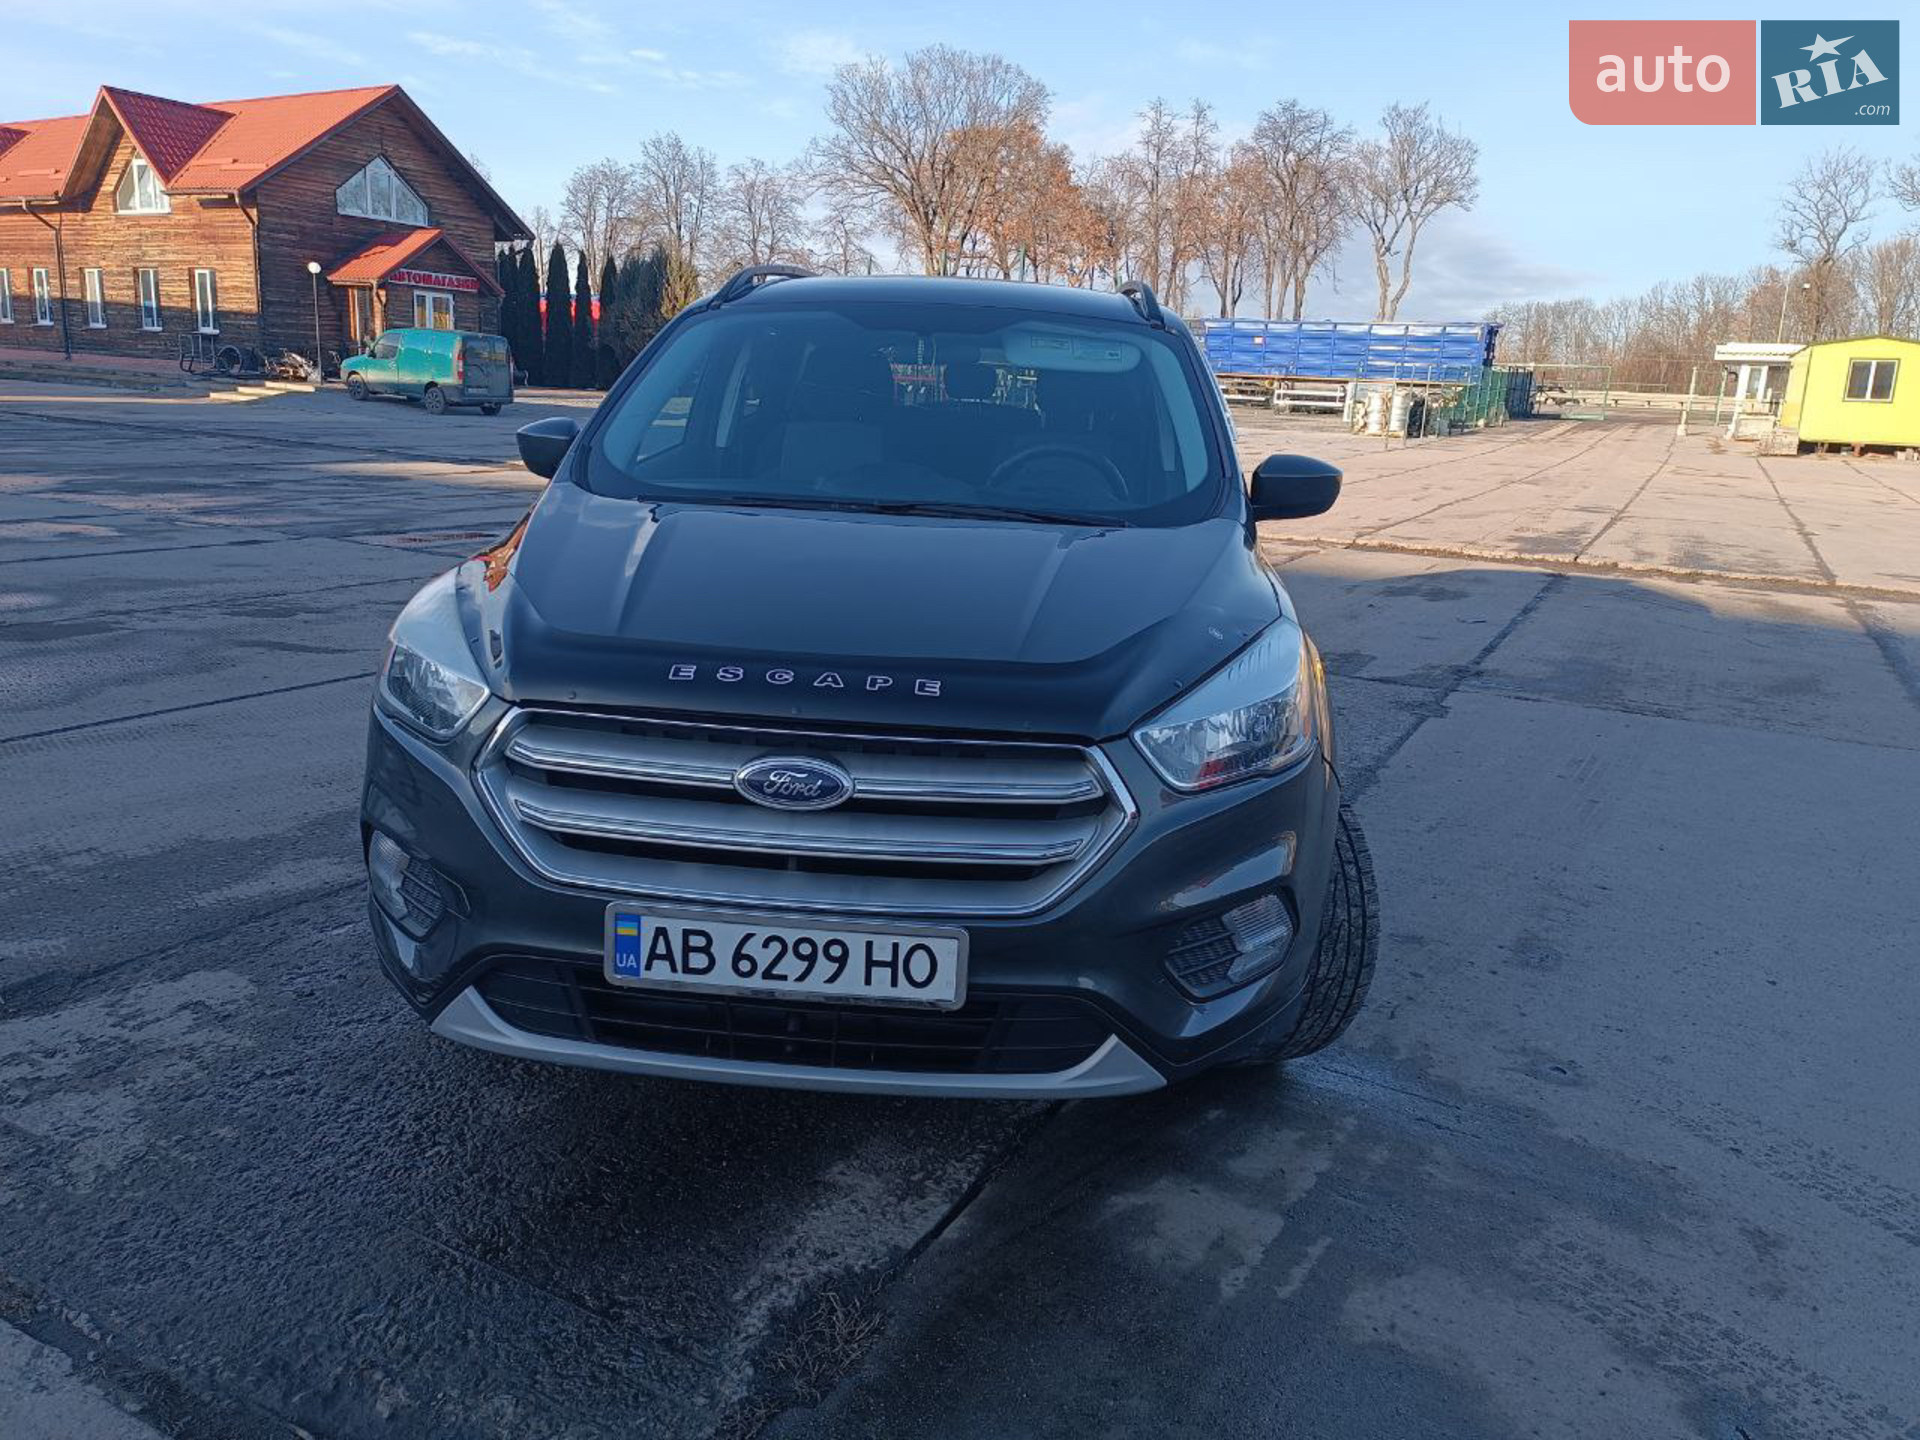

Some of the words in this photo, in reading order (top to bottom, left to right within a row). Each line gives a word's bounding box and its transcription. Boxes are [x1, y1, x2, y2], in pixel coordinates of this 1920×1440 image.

[668, 664, 942, 697] ESCAPE
[763, 770, 822, 798] Ford
[615, 952, 637, 968] UA
[644, 926, 716, 975] AB
[731, 933, 850, 984] 6299
[864, 940, 938, 989] HO
